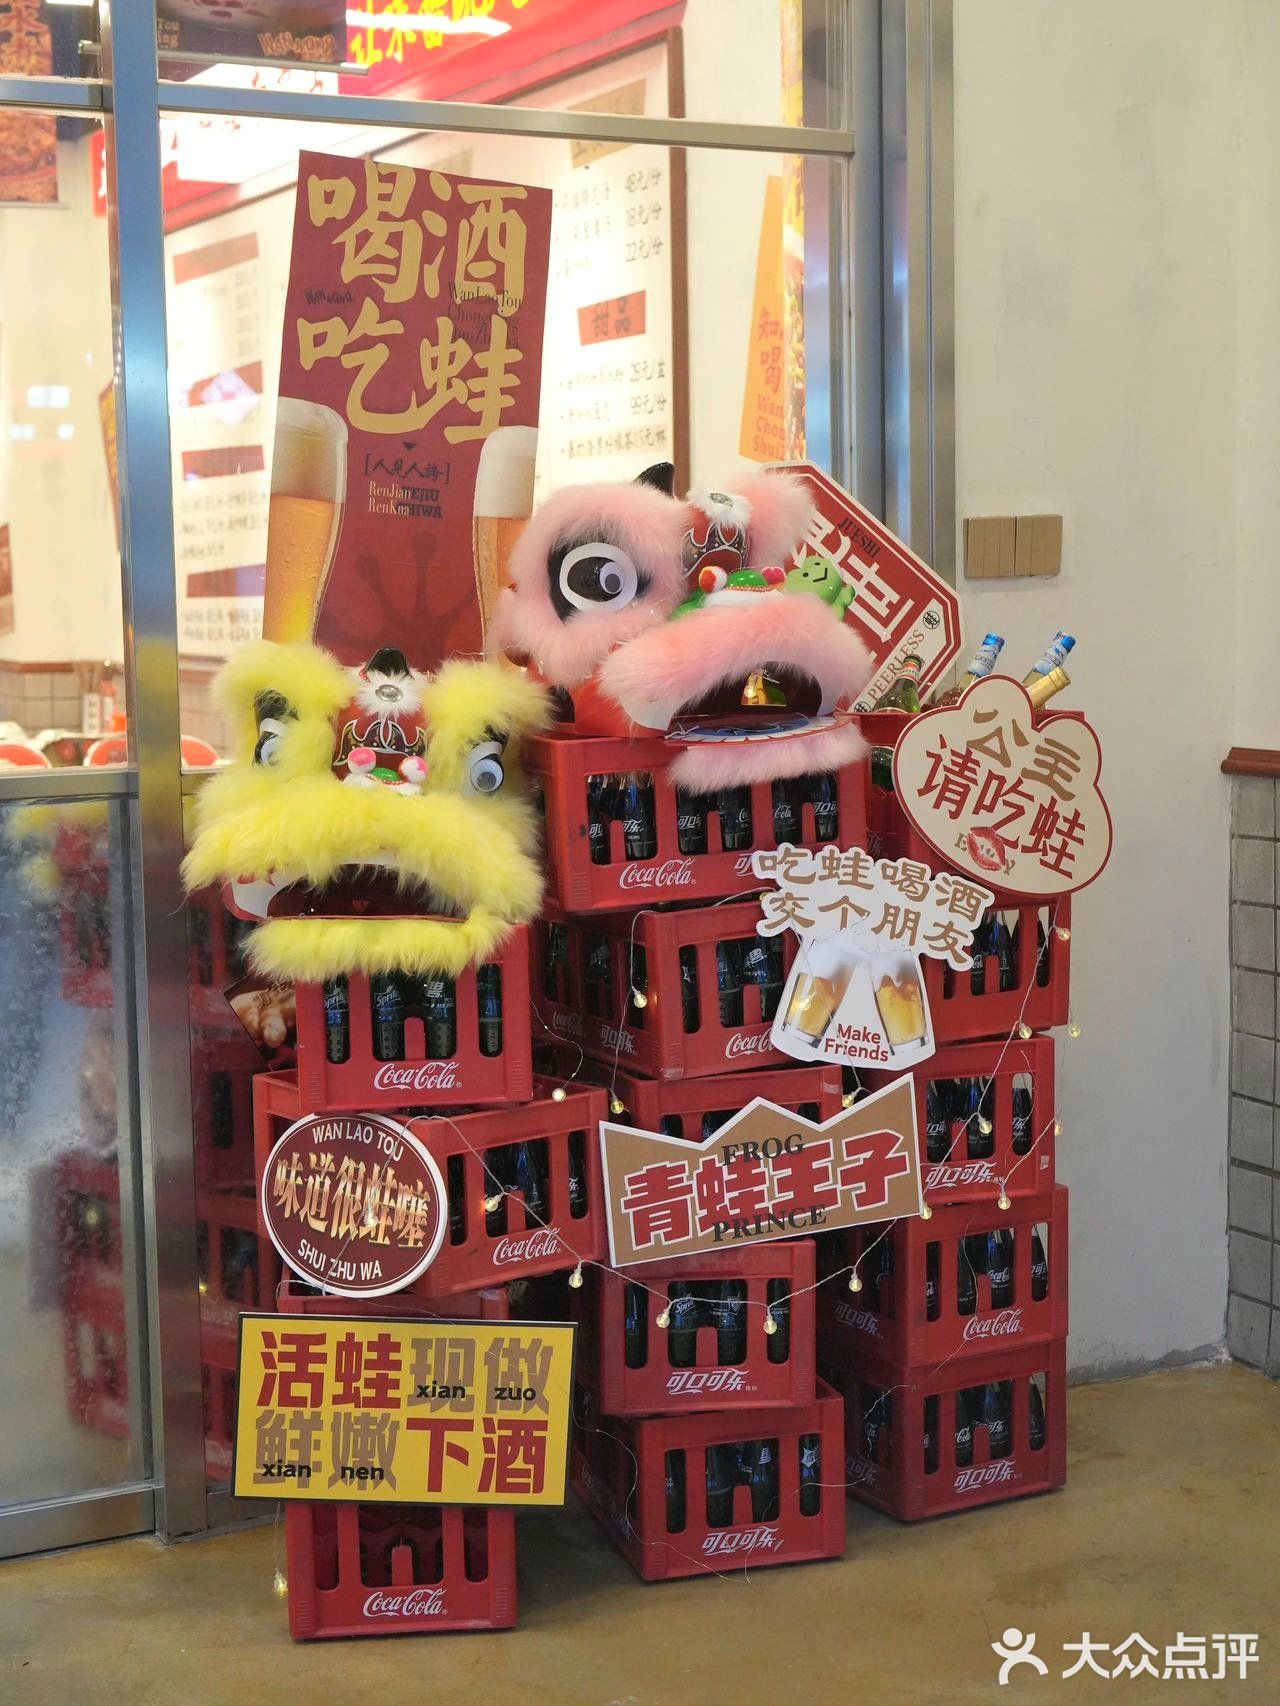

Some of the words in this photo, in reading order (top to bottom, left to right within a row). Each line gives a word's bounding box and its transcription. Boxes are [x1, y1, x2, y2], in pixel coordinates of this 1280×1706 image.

[307, 154, 528, 317] 喝酒
[297, 298, 523, 444] 吃蛙
[838, 517, 880, 559] JUESHI
[866, 629, 926, 702] PEERLESS
[967, 708, 1081, 801] 公主
[917, 734, 1086, 879] 请吃蛙
[759, 846, 990, 923] 吃蛙喝酒
[764, 892, 969, 964] 交个朋友
[824, 1038, 890, 1062] Friends
[837, 1024, 881, 1044] Make
[312, 1123, 343, 1145] WAN
[346, 1122, 373, 1144] LAO
[377, 1131, 404, 1162] TOU
[721, 1133, 804, 1167] FROG
[621, 1129, 911, 1250] 青蛙王子
[925, 1161, 997, 1190] 可口可乐
[713, 1204, 827, 1242] PRINCE
[298, 1239, 327, 1272] SHUI
[327, 1258, 356, 1281] ZHU
[360, 1260, 383, 1281] WA
[256, 1331, 554, 1416] 活蛙现做
[416, 1381, 467, 1400] xian
[494, 1386, 537, 1401] zuo
[666, 1368, 749, 1396] 可口可乐
[262, 1459, 312, 1479] xian
[340, 1465, 385, 1481] nen
[954, 1460, 1017, 1493] 可口可乐
